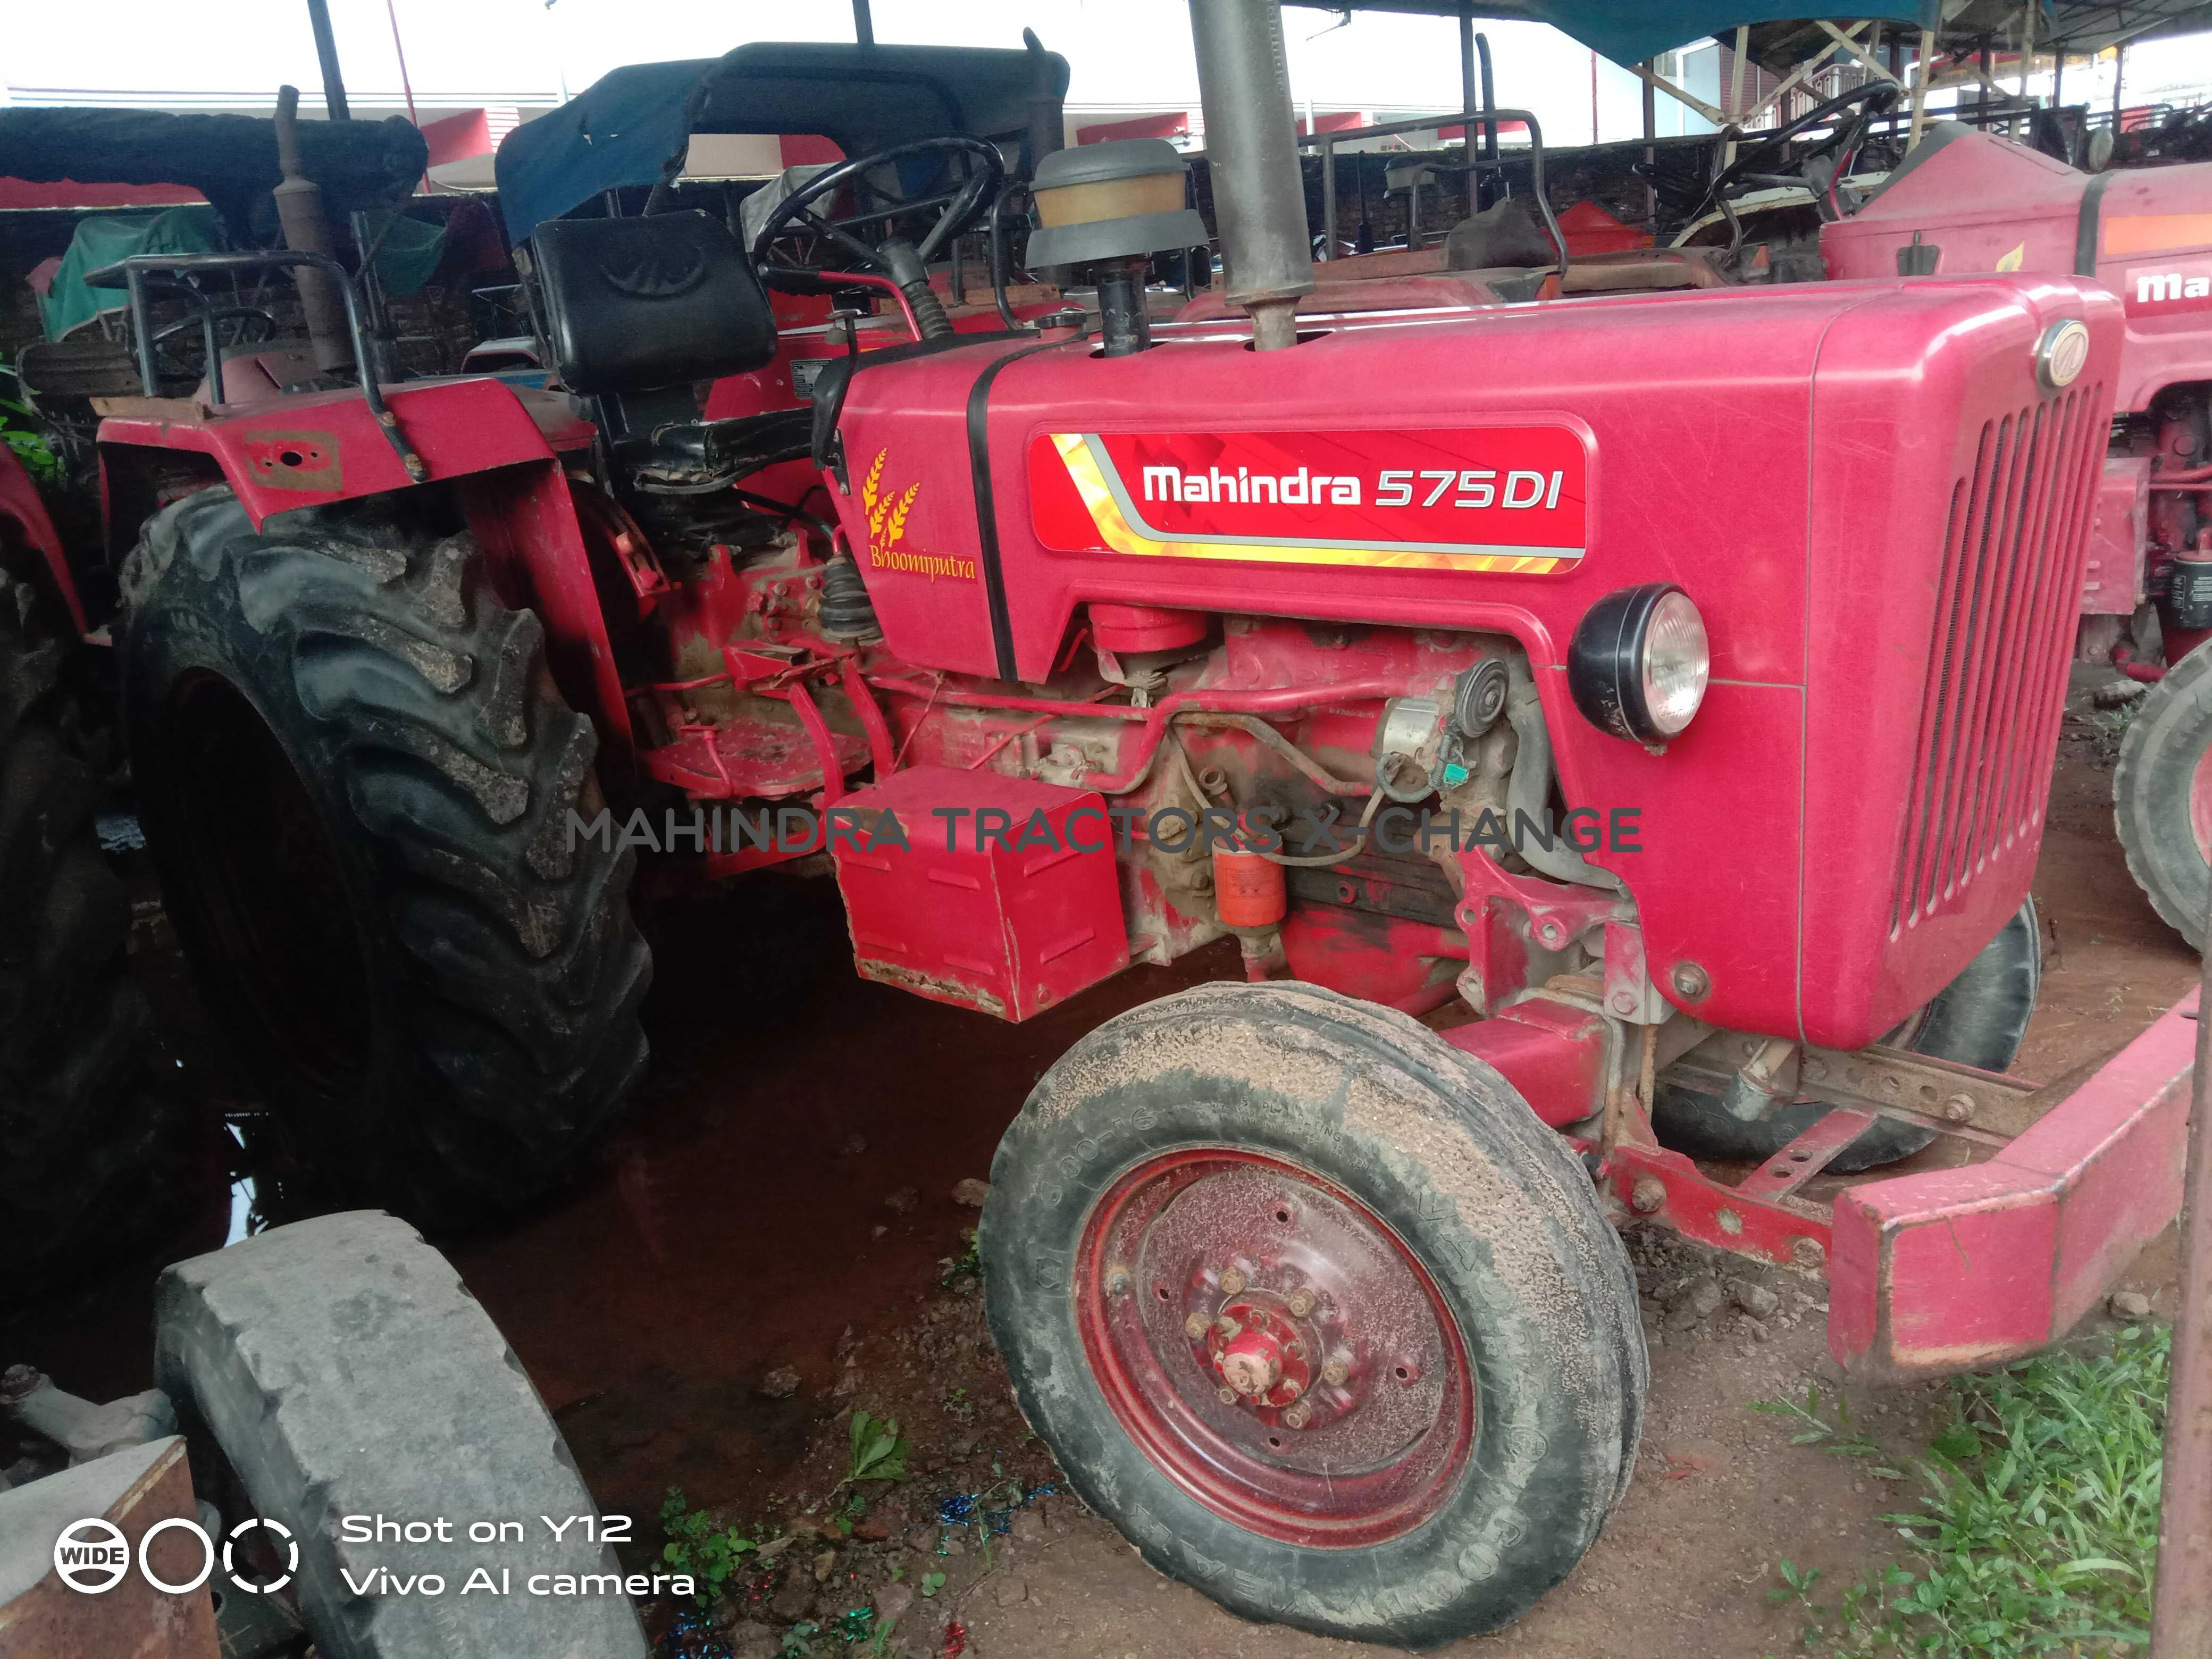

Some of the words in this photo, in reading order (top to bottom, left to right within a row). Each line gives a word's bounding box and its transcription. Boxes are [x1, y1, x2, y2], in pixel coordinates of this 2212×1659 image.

[1143, 466, 1361, 505] Mahindra
[1375, 470, 1496, 507] 575
[1501, 470, 1564, 509] DI
[869, 545, 976, 584] Bhoomiputra
